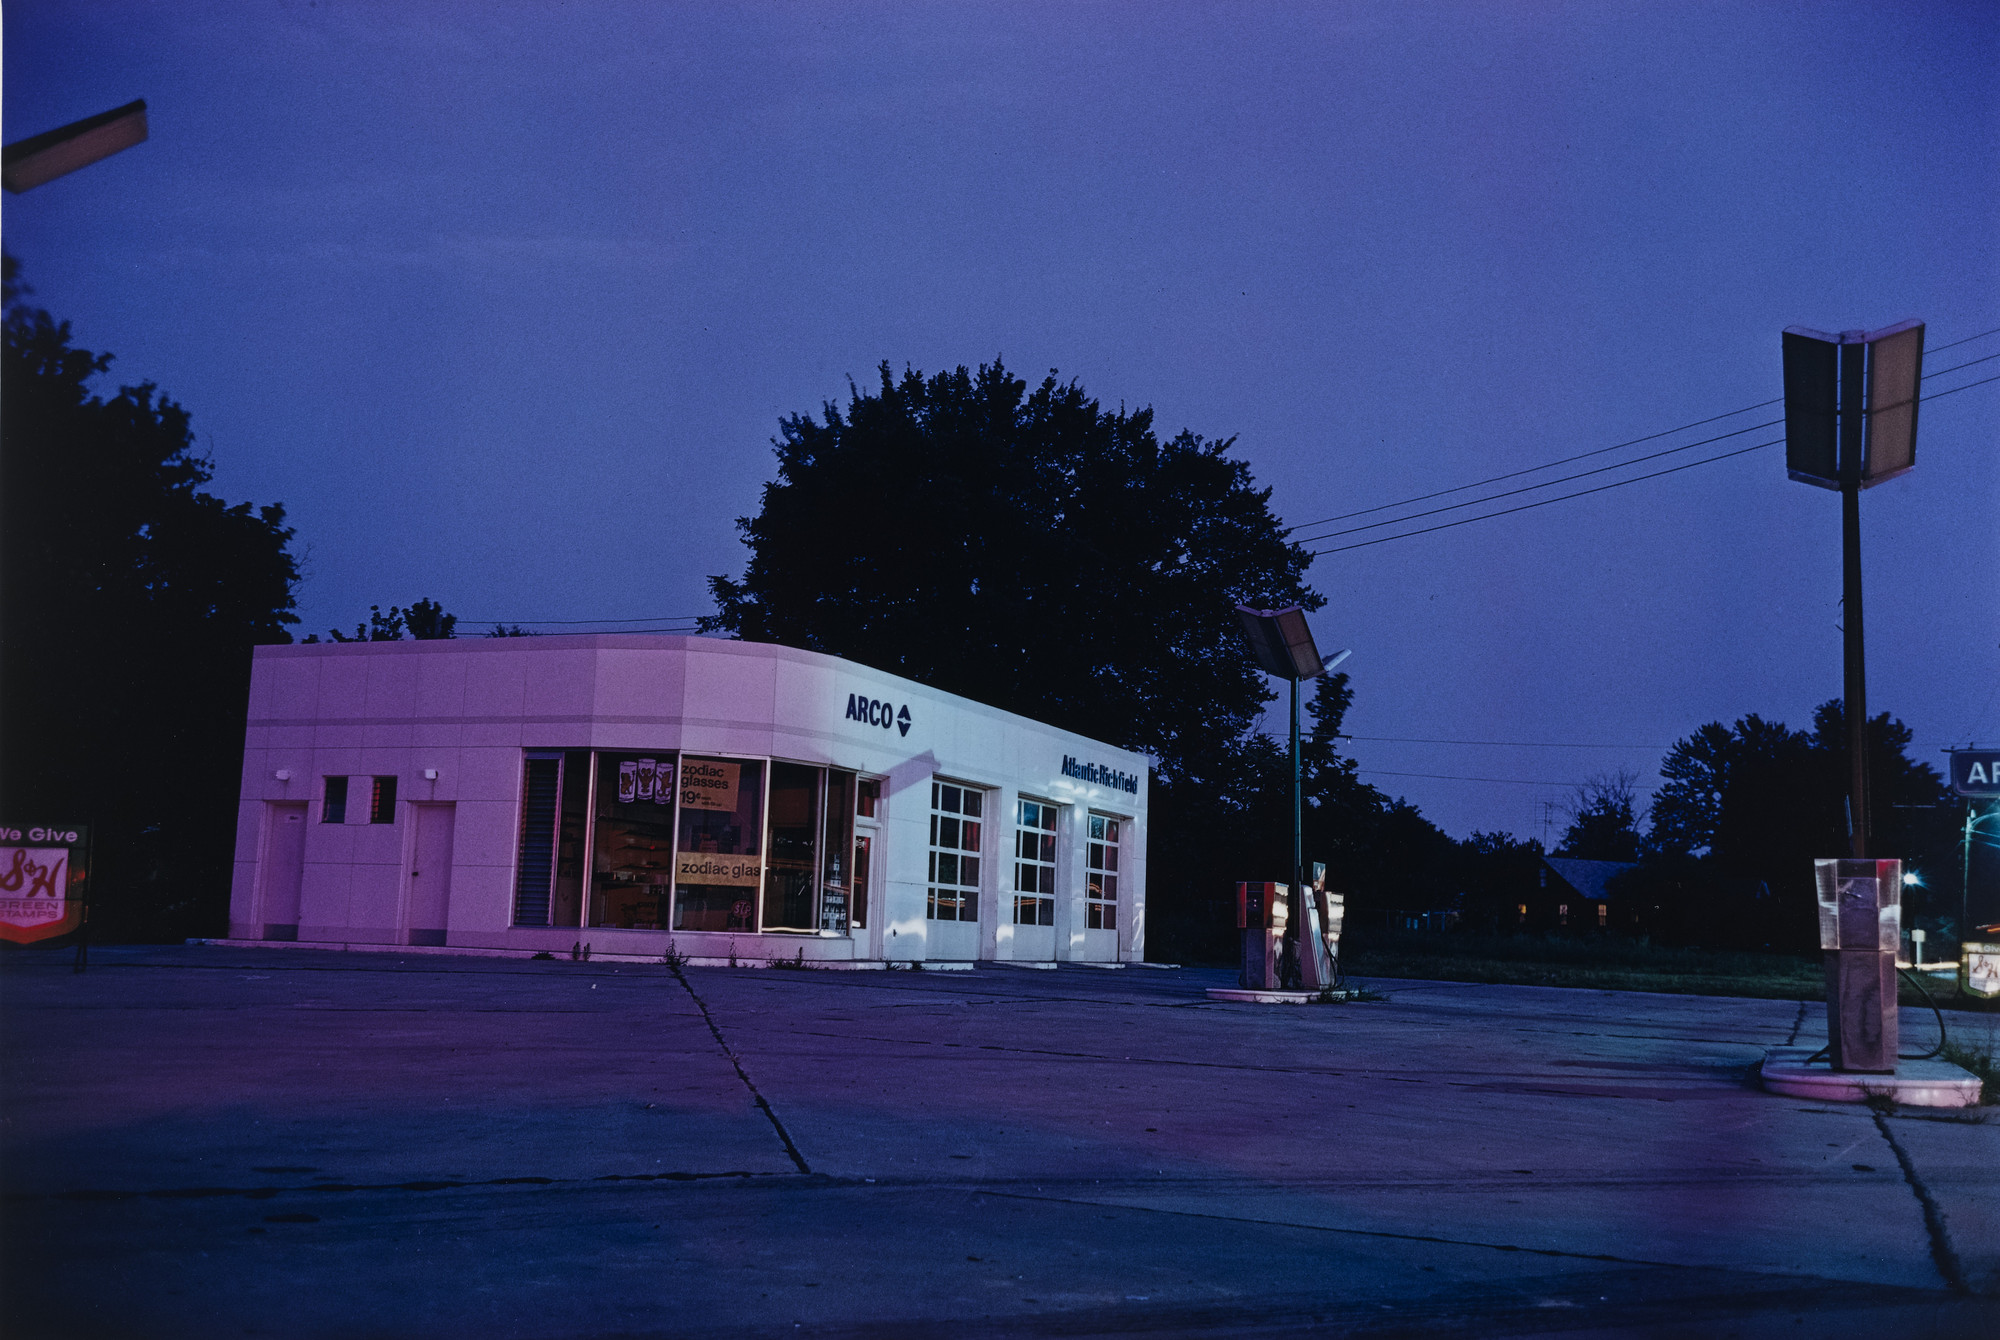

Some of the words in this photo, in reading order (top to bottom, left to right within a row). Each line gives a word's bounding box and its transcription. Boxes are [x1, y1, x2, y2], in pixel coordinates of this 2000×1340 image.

[845, 693, 894, 729] ARCO
[681, 764, 724, 778] zodiac
[681, 775, 729, 789] glasses
[28, 827, 78, 843] Give
[0, 848, 65, 898] S&H
[681, 861, 729, 876] zodiac
[733, 901, 752, 915] STP
